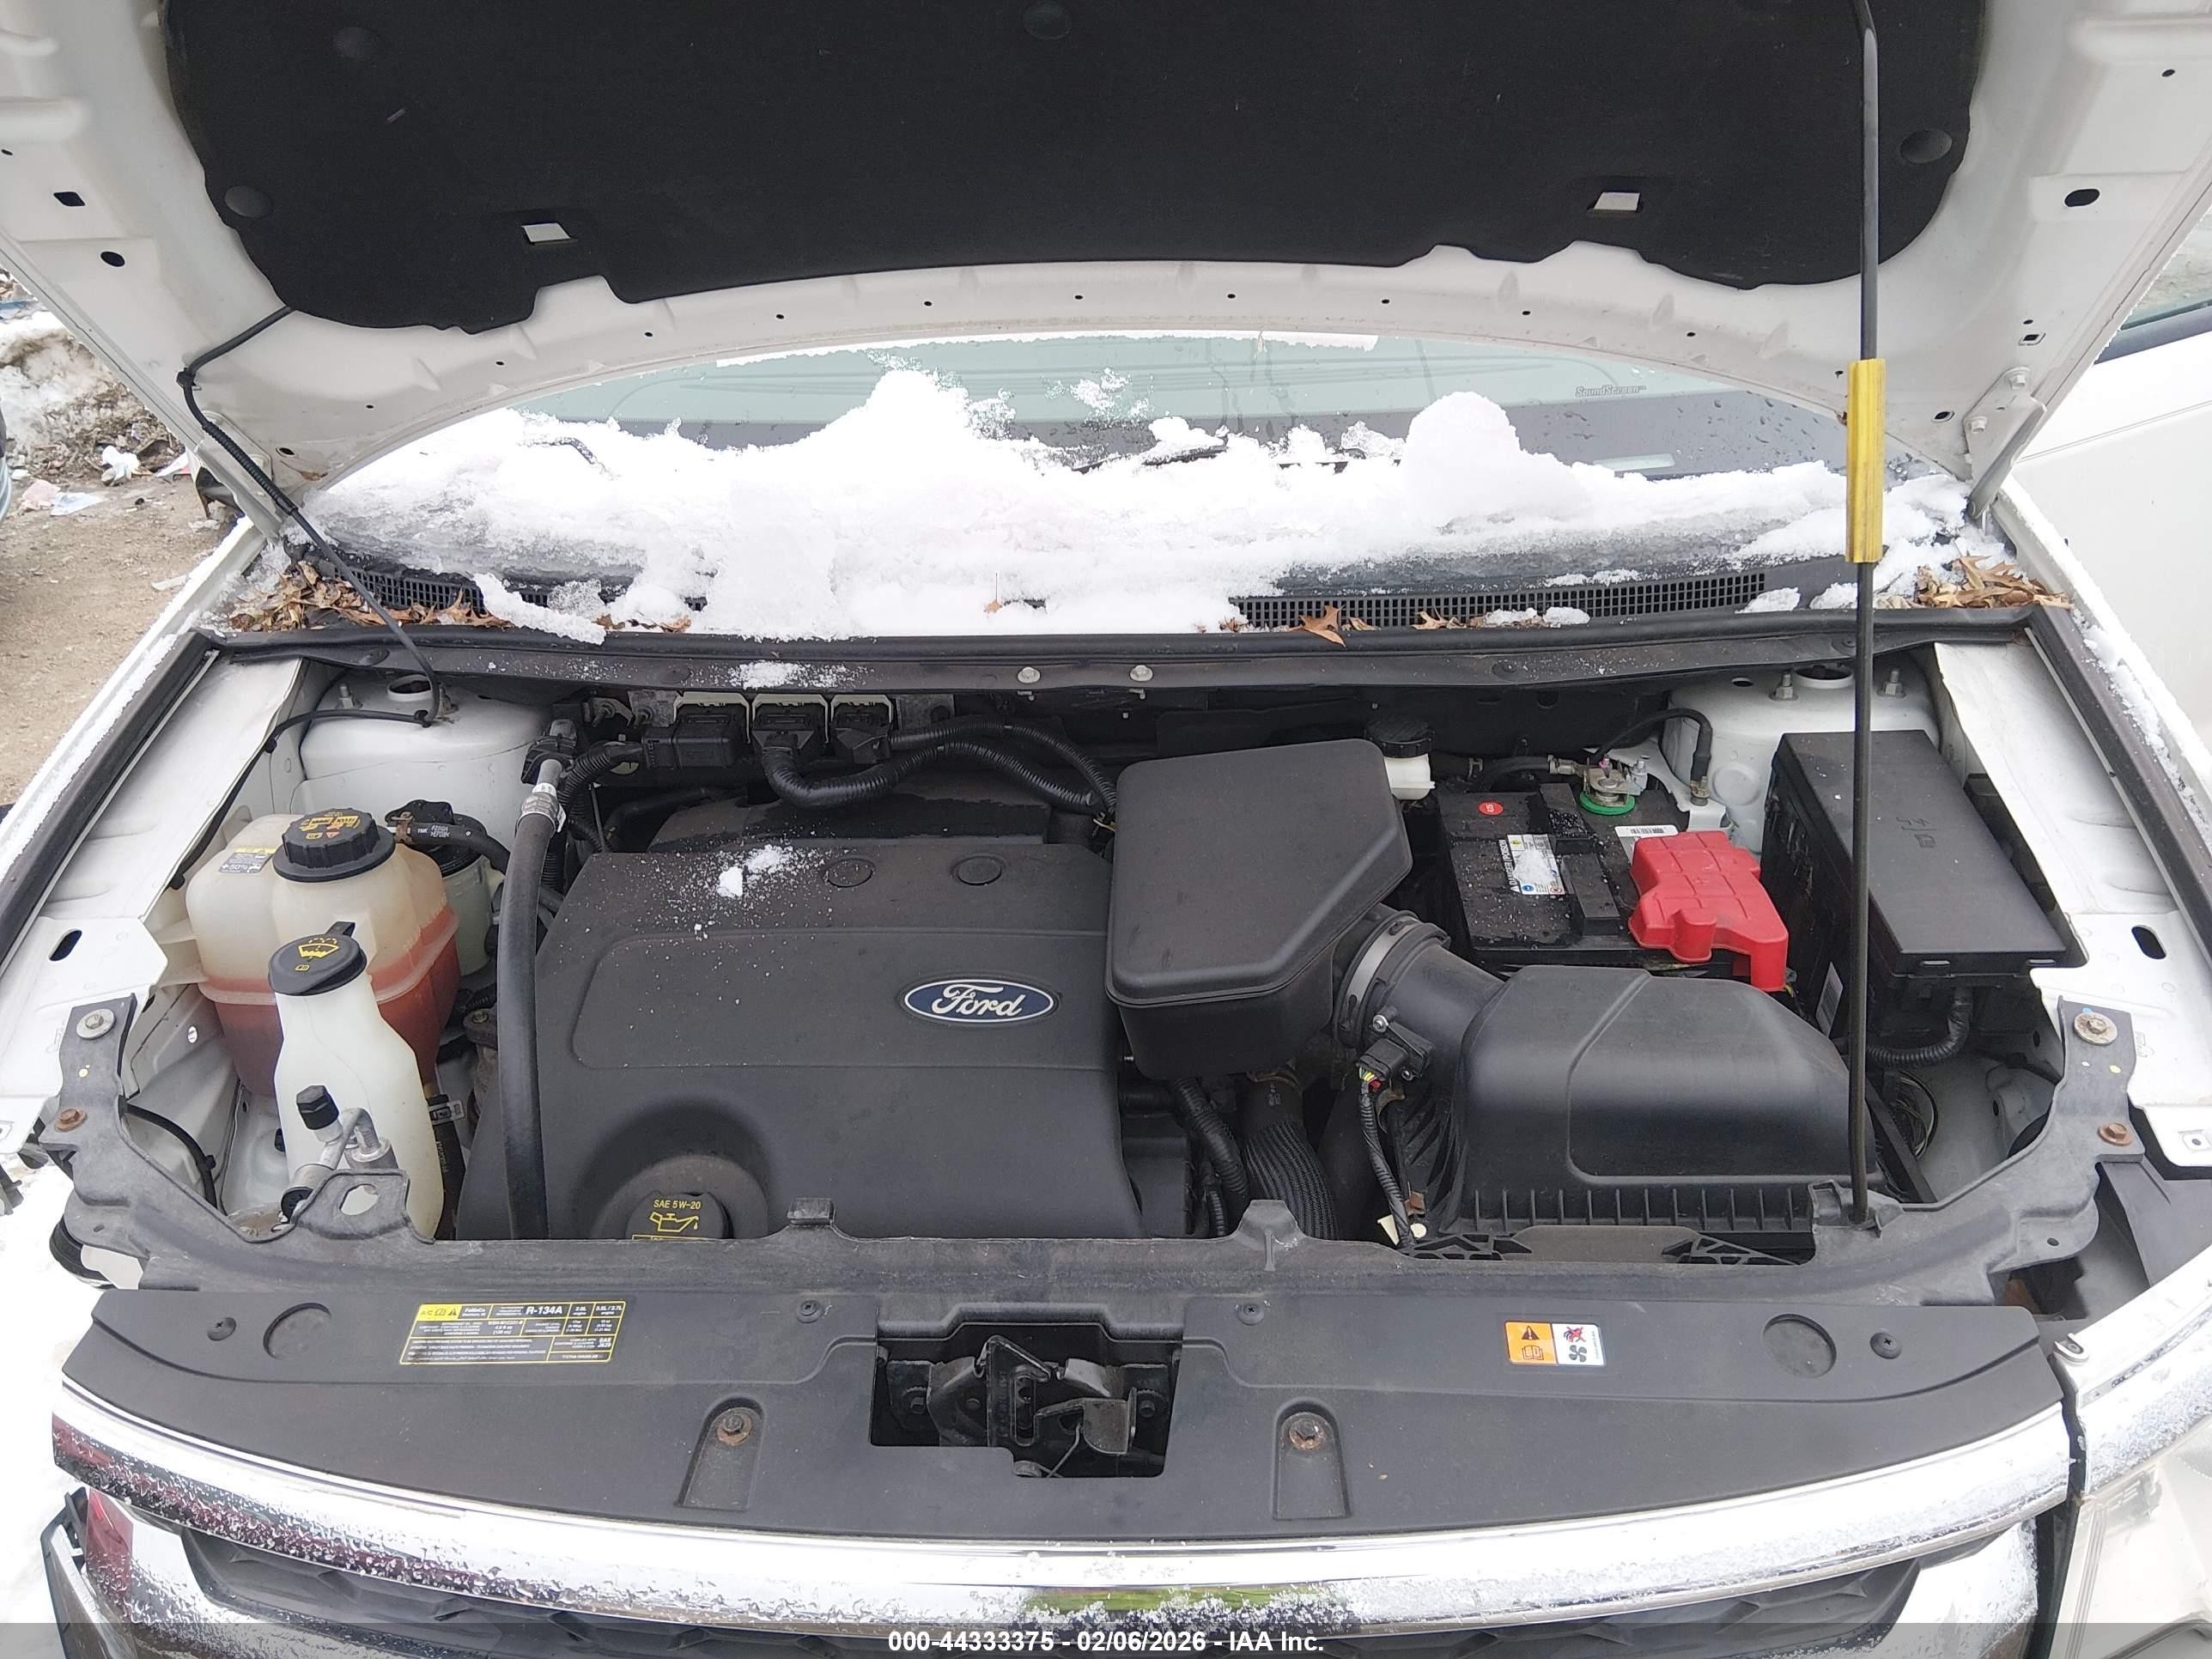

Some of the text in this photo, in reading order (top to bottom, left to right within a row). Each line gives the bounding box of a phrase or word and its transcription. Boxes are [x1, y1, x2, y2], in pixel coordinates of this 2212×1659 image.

[932, 983, 1026, 1017] Ford
[653, 1199, 702, 1210] SAE 5W-20
[525, 1305, 563, 1316] R-134A
